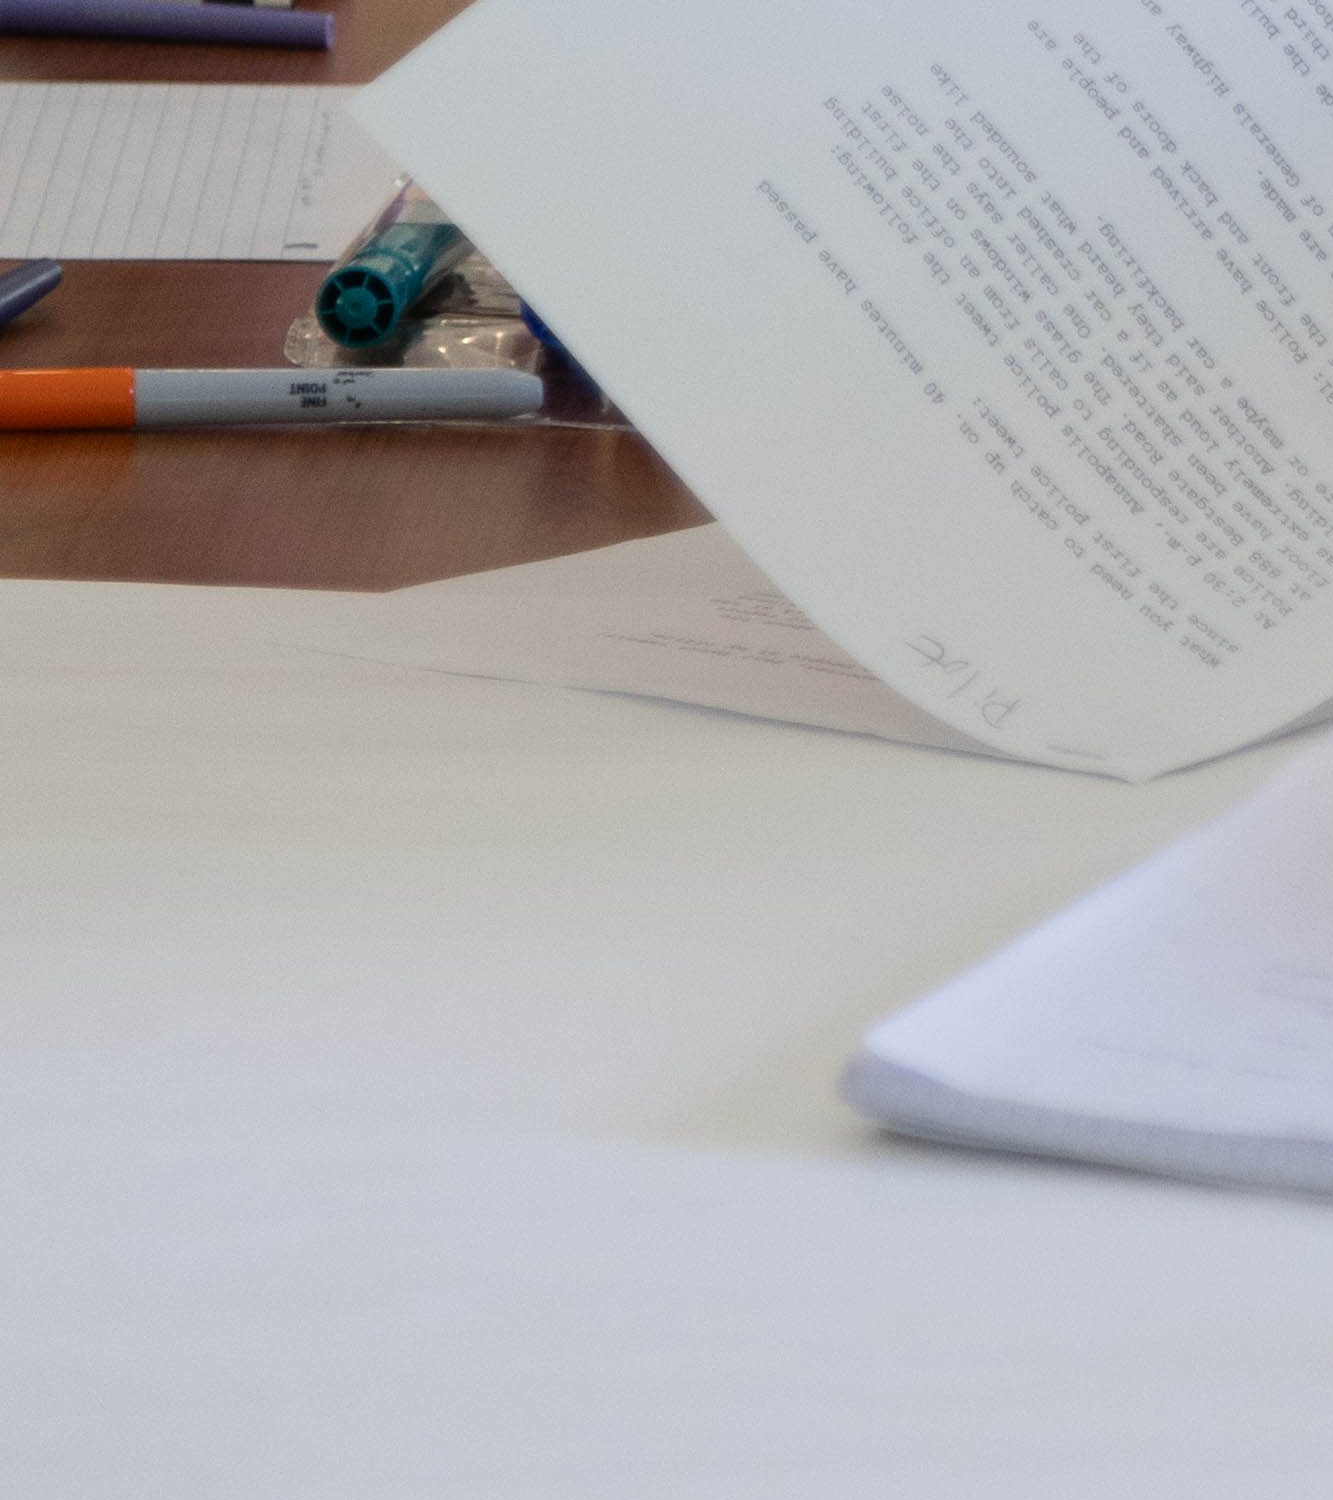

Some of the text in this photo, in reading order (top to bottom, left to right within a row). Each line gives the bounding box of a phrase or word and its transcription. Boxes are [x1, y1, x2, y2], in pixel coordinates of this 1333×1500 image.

[1027, 19, 1057, 50] are
[1165, 23, 1230, 97] Highway
[1283, 43, 1310, 76] the
[930, 63, 968, 105] like
[1061, 57, 1120, 120] people
[944, 118, 973, 150] the
[969, 110, 1037, 182] sounded
[1116, 125, 1150, 158] and
[1232, 102, 1300, 187] Generals
[978, 157, 1016, 198] into
[1257, 170, 1297, 222] made.
[1041, 191, 1076, 234] what
[1149, 165, 1213, 240] arrived
[1300, 194, 1324, 216] of
[1016, 205, 1080, 280] crashed
[1299, 228, 1327, 261] are
[1077, 240, 1125, 298] heard
[1097, 215, 1185, 332] backfiring.
[1216, 248, 1253, 294] have
[1084, 290, 1111, 321] car
[1127, 303, 1163, 347] they
[862, 101, 1311, 599] at 888 Bestgate Road. The glass windows on the first
[1116, 329, 1129, 341] a
[1186, 337, 1215, 369] car
[1255, 299, 1308, 364] Police
[822, 96, 1293, 616] Police are responding to calls from an office building
[1128, 350, 1152, 371] if
[1165, 353, 1205, 395] said
[290, 382, 327, 396] POINT
[300, 396, 327, 409] FINE
[830, 144, 1277, 629] At 2:30 p.m., Annapolis police tweet the following:
[1157, 380, 1177, 400] as
[1220, 376, 1233, 388] a
[755, 179, 1221, 669] What you need to catch up on. 40 minutes have passed
[1178, 408, 1219, 452] loud
[1209, 405, 1275, 474] Another
[1237, 396, 1284, 449] maybe
[1288, 455, 1308, 476] or
[1224, 459, 1308, 540] extremely
[972, 396, 1239, 652] since the first police tweet:
[905, 633, 1021, 730] Pilot
